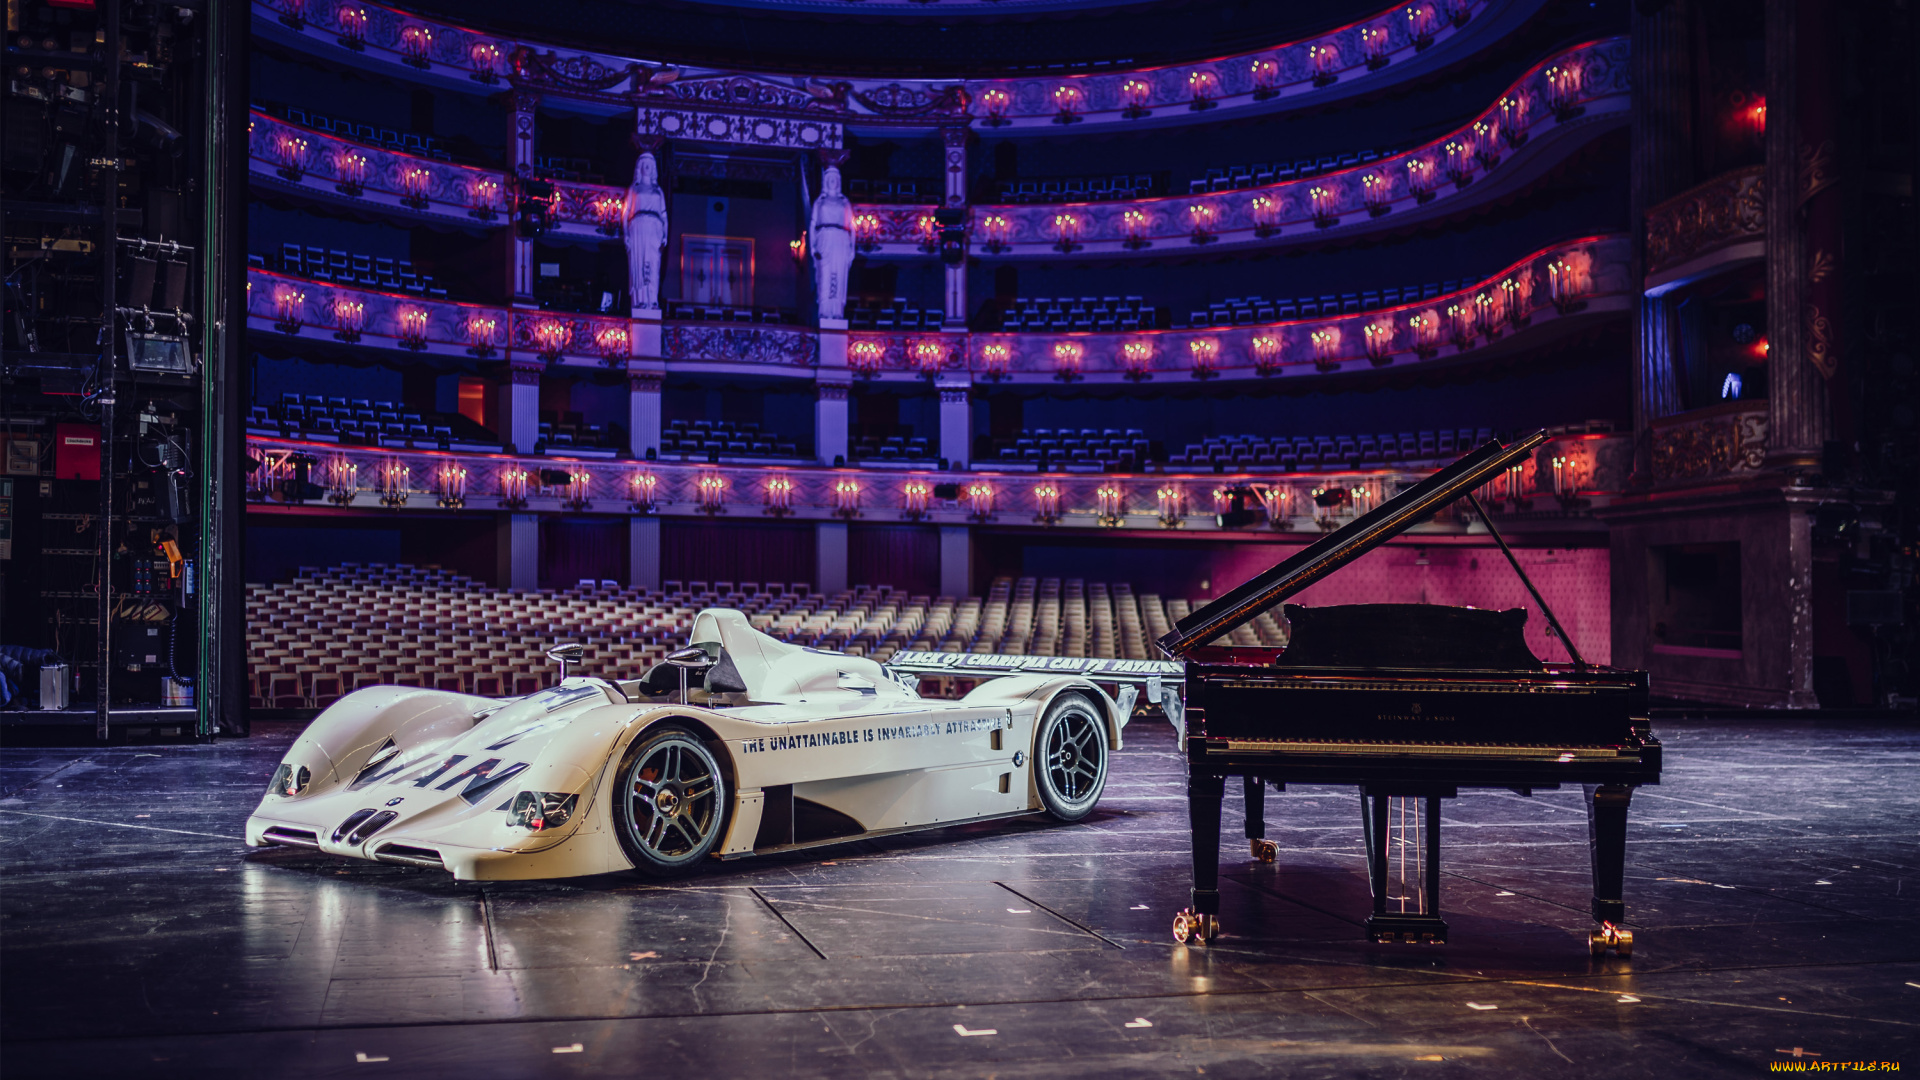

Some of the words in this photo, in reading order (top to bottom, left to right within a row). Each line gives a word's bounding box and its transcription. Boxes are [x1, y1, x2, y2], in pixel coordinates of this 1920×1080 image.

[903, 652, 943, 663] LACK
[967, 655, 1048, 669] CHARISMA
[1049, 658, 1085, 669] CAN
[741, 737, 765, 753] THE
[770, 730, 859, 750] UNATTAINABLE
[863, 728, 874, 742] IS
[877, 723, 941, 741] INVARIABLY
[946, 717, 1002, 735] ATTRACTIVE
